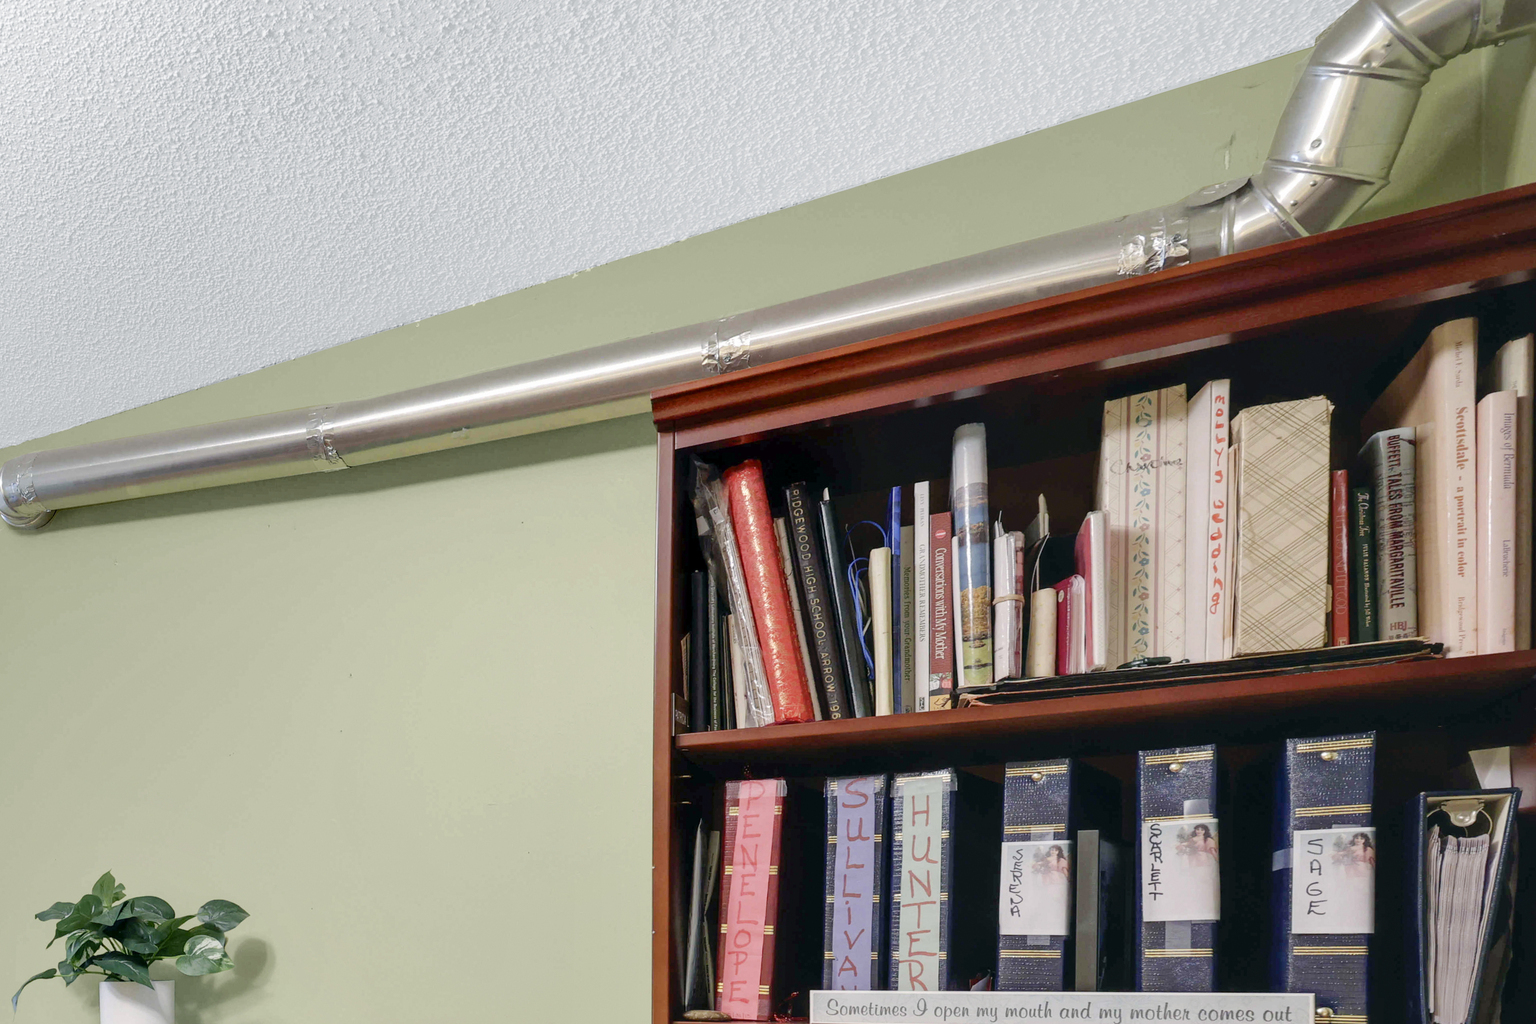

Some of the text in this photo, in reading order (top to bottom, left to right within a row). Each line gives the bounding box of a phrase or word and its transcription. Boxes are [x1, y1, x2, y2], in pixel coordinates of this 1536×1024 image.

[1456, 406, 1469, 470] Scottsdale
[1500, 412, 1514, 490] Images of Bermuda
[1387, 472, 1403, 501] TALES
[791, 489, 812, 560] RIDGEWOOD
[1388, 502, 1403, 530] FROM
[1454, 495, 1467, 535] portrait
[1457, 538, 1467, 548] in
[804, 565, 817, 593] HIGH
[904, 566, 912, 599] Memories
[1335, 573, 1347, 590] LET
[1389, 530, 1406, 609] MARGARITAVILLE
[1457, 551, 1467, 578] color
[810, 598, 826, 646] SCHOOL
[932, 547, 947, 659] Conversations with My Mother
[1335, 591, 1347, 615] GOD
[1390, 621, 1408, 631] HBJ
[820, 652, 836, 692] ARROW
[904, 636, 912, 681] Grandmother
[1148, 823, 1163, 901] SCARLETT
[1305, 838, 1329, 917] SAGE
[729, 779, 767, 1004] PENELOPE
[899, 794, 939, 991] HUNTER
[826, 998, 907, 1017] Sometimes
[934, 1004, 969, 1019] open
[976, 1006, 998, 1023] my
[1005, 1001, 1052, 1018] mouth
[1059, 1002, 1091, 1020] and
[1099, 1007, 1122, 1024] my
[1130, 1002, 1191, 1021] mother
[1197, 1008, 1255, 1022] comes
[1262, 1005, 1292, 1022] out
